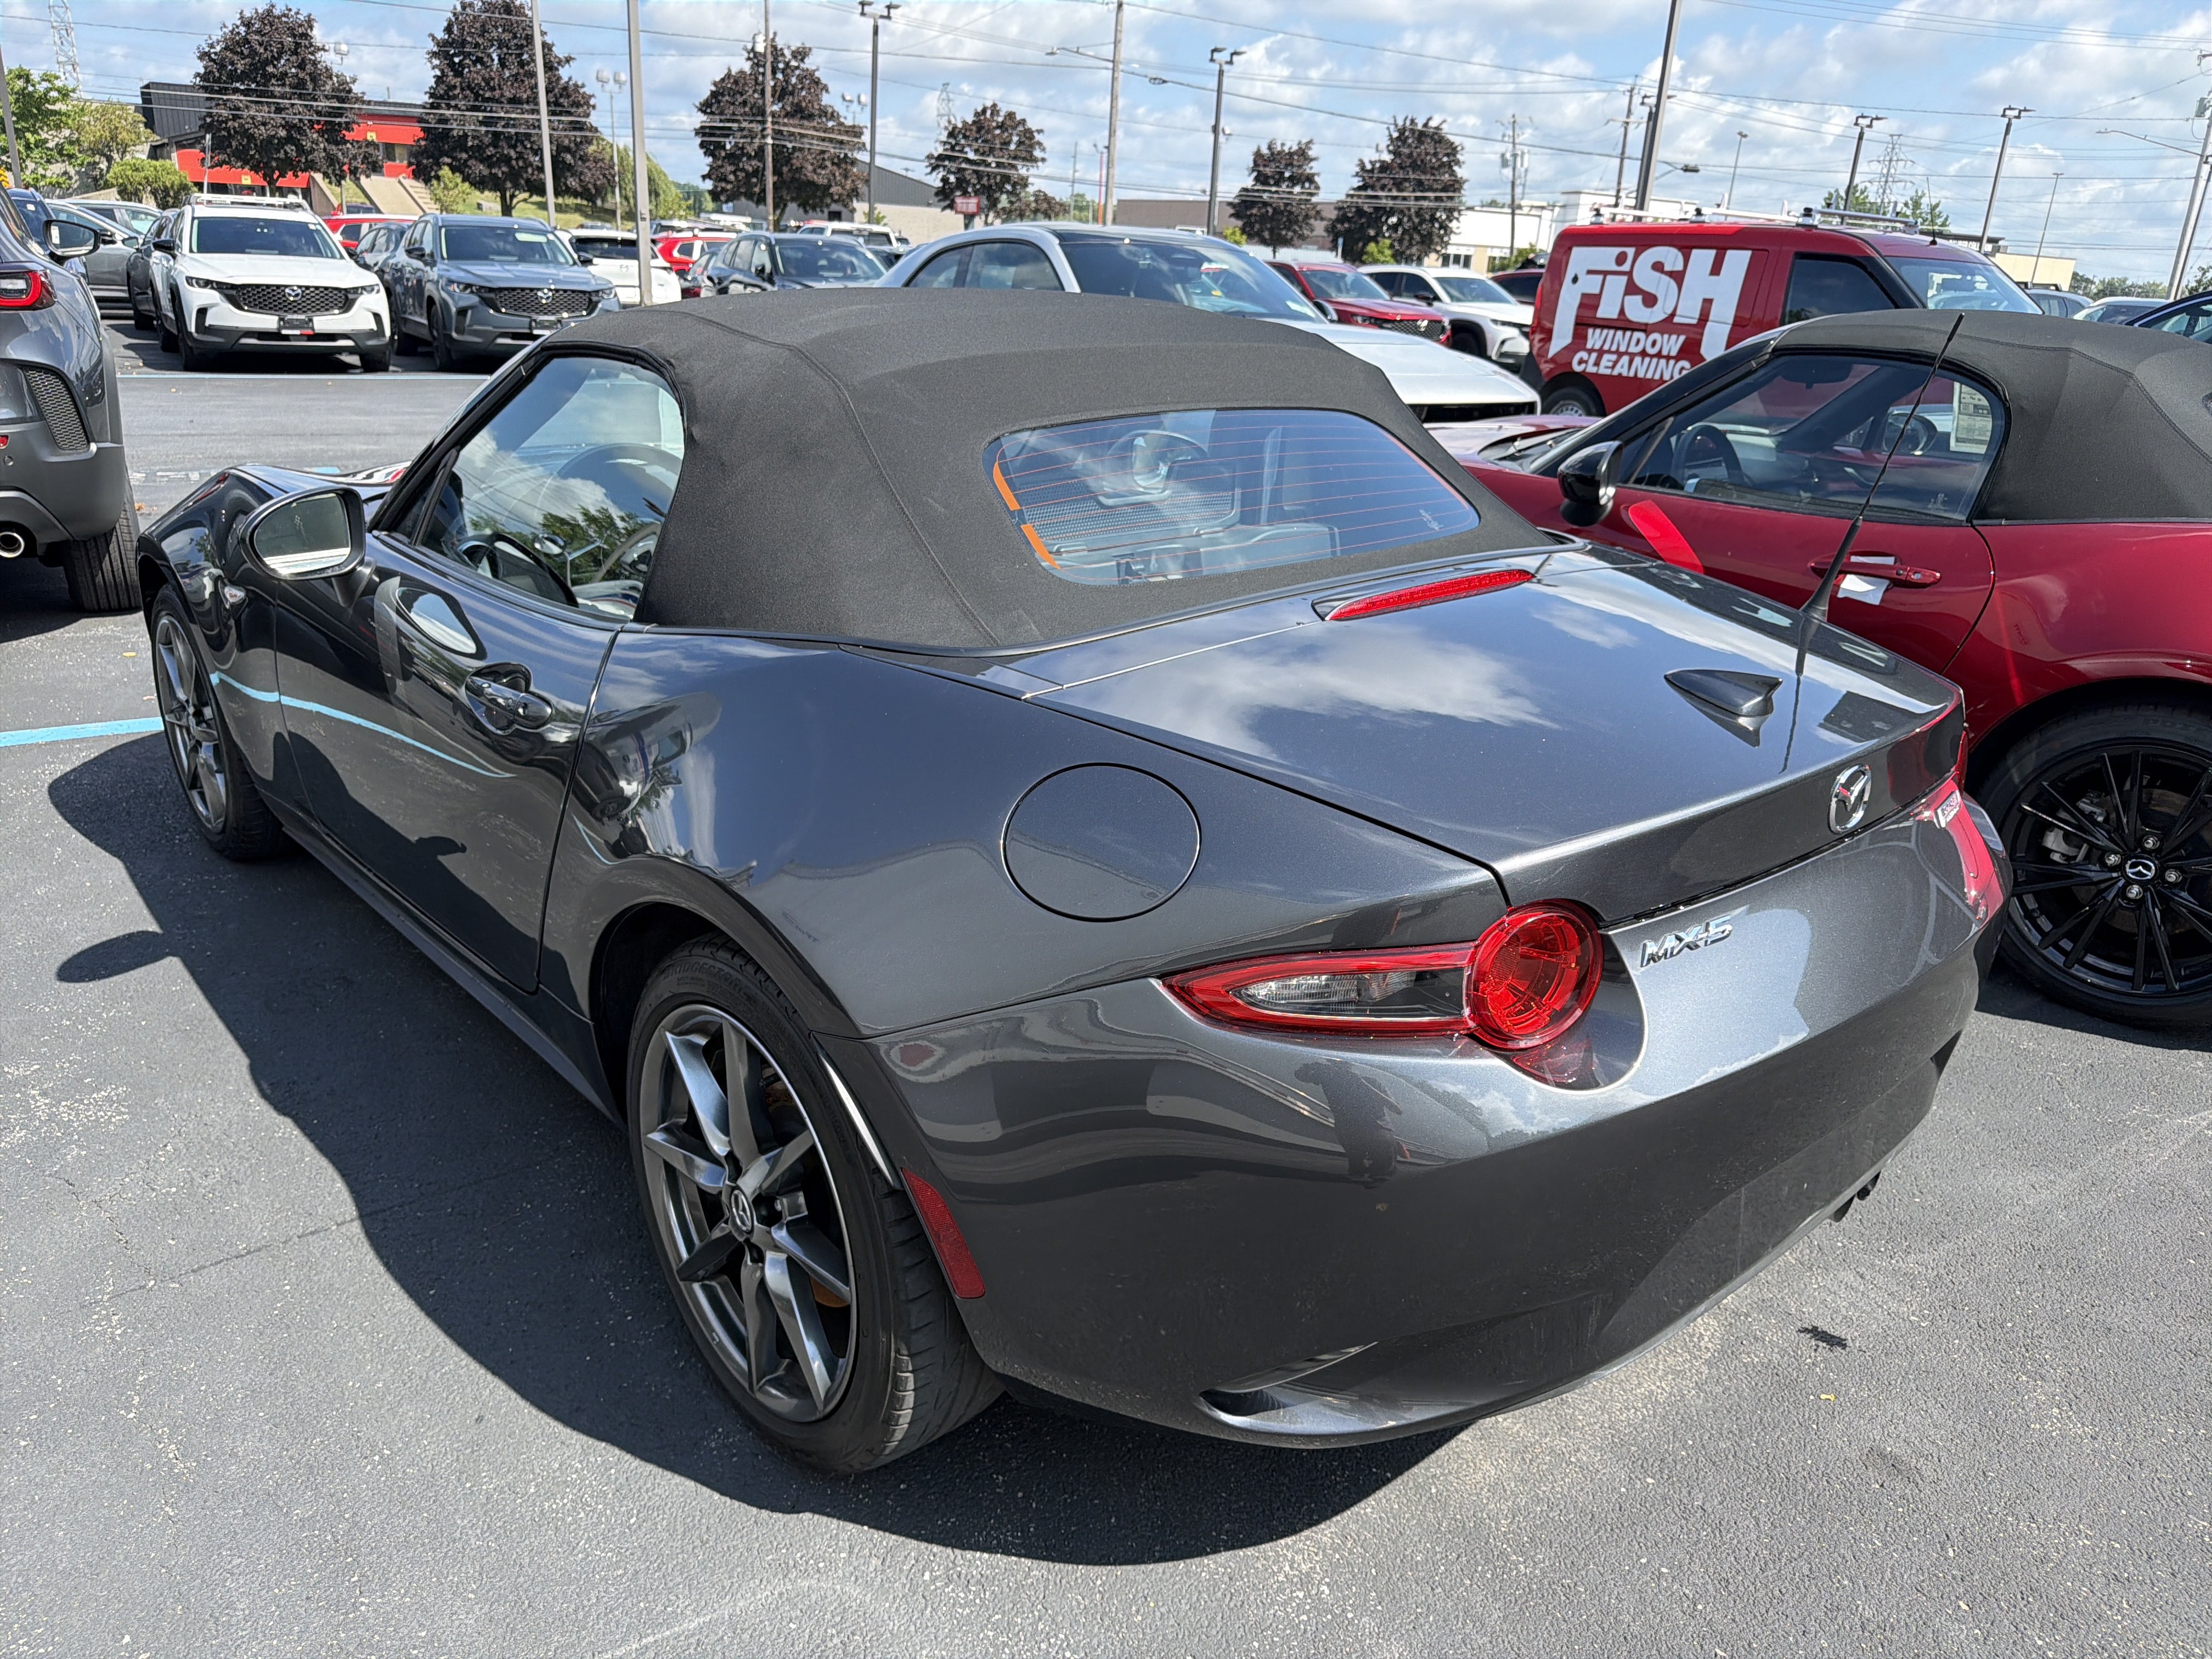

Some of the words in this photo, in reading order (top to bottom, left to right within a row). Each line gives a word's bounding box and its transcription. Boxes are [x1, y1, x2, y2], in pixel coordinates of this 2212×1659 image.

[1585, 328, 1686, 357] WINDOW
[1571, 350, 1691, 381] CLEANING
[1640, 915, 1733, 968] MX-5
